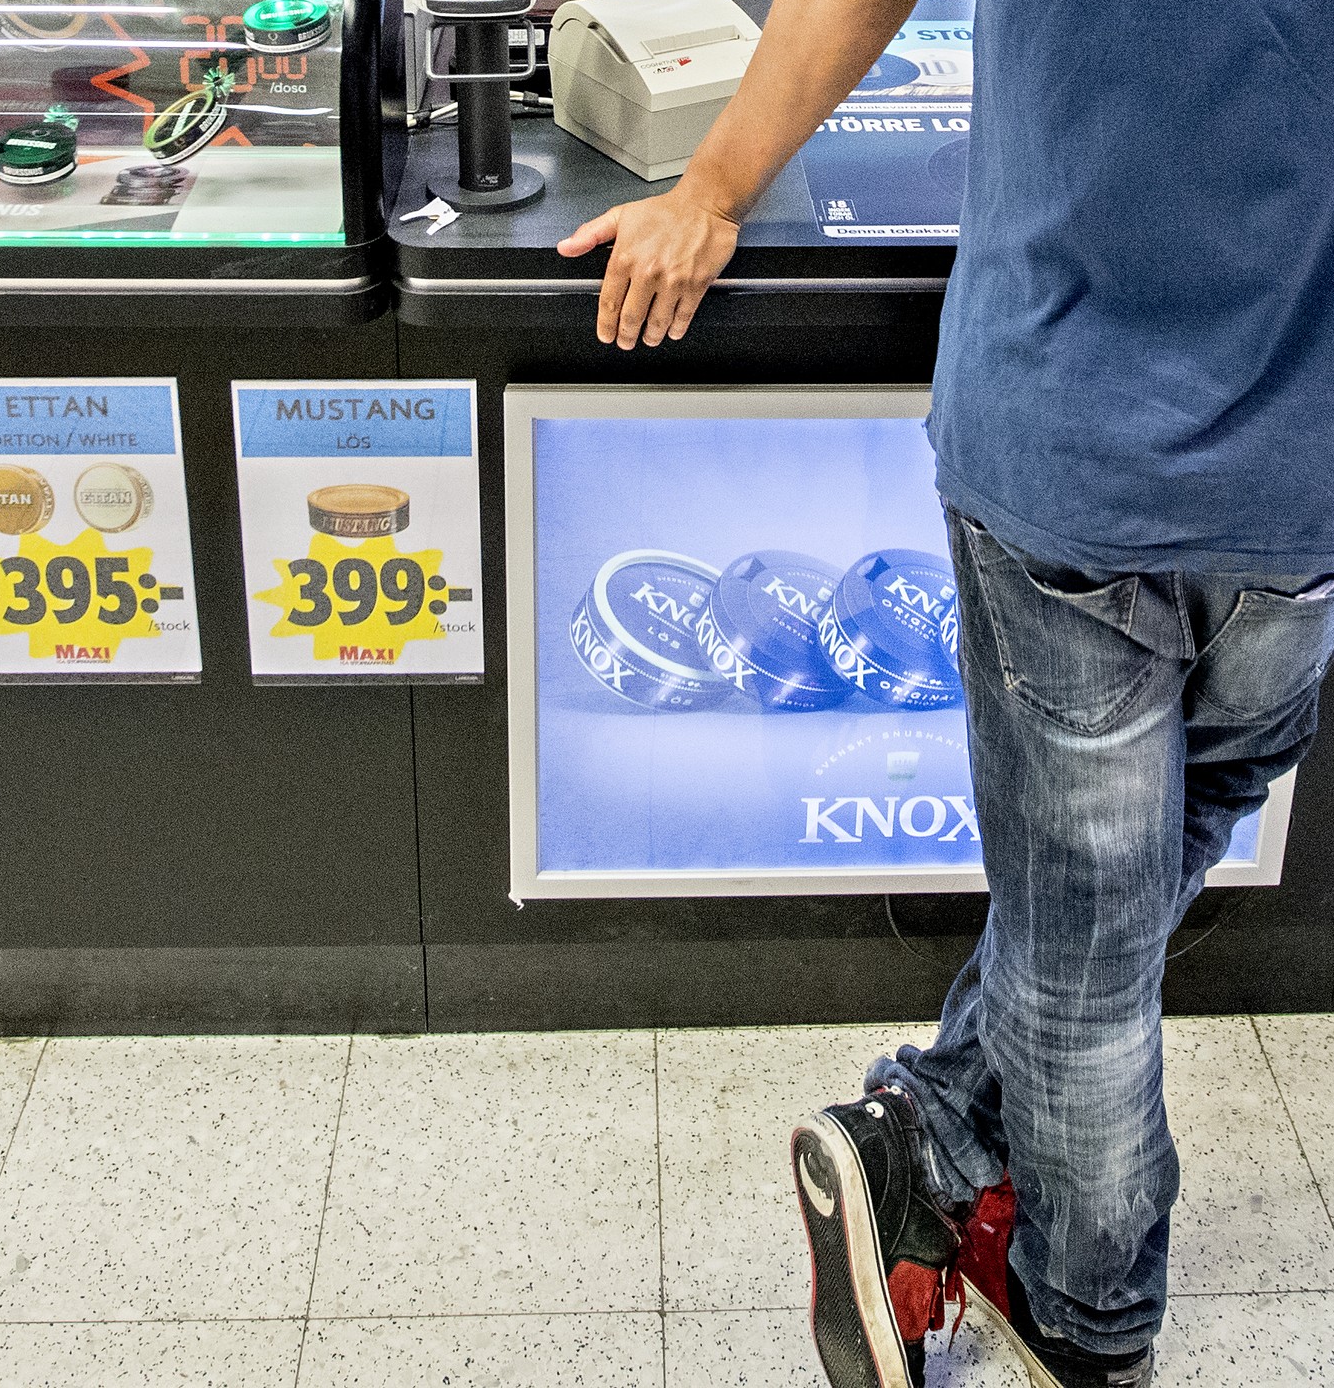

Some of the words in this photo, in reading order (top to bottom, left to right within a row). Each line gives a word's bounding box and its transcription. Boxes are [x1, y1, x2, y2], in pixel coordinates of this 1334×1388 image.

[269, 81, 307, 94] /dosa
[816, 117, 924, 132] TÖRRE
[837, 227, 885, 235] Denna
[5, 395, 108, 418] ETTAN
[275, 398, 435, 421] MUSTANG
[79, 433, 137, 447] WHITE
[337, 435, 371, 449] LÖS
[79, 491, 132, 504] ETTAN
[0, 556, 184, 626] 395:-
[287, 558, 472, 627] 399:-
[147, 620, 190, 632] /stock
[433, 622, 476, 633] /stock
[55, 644, 110, 659] MAXI
[339, 646, 394, 661] MAXI
[571, 608, 635, 692] KNOX
[695, 607, 757, 691] KNOX
[818, 607, 879, 691] KNOX
[799, 795, 983, 844] KNOX
